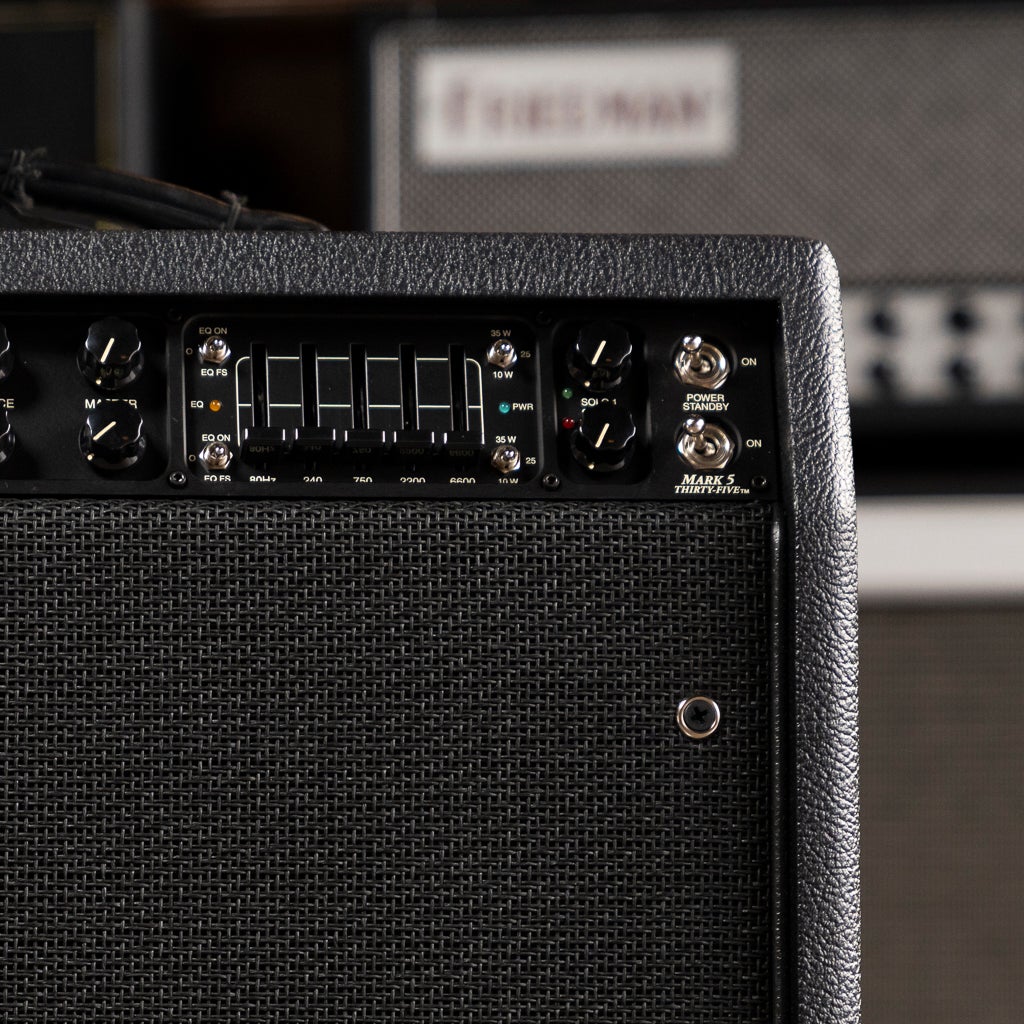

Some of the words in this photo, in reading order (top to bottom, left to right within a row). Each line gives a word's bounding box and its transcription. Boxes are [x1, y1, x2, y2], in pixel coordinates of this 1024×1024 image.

[741, 358, 757, 366] ON
[687, 394, 725, 402] POWER
[683, 402, 729, 411] STANDBY
[202, 434, 215, 442] EQ
[682, 474, 723, 485] MARK
[726, 474, 735, 484] 5
[675, 486, 740, 494] THIRTY-FIVE
